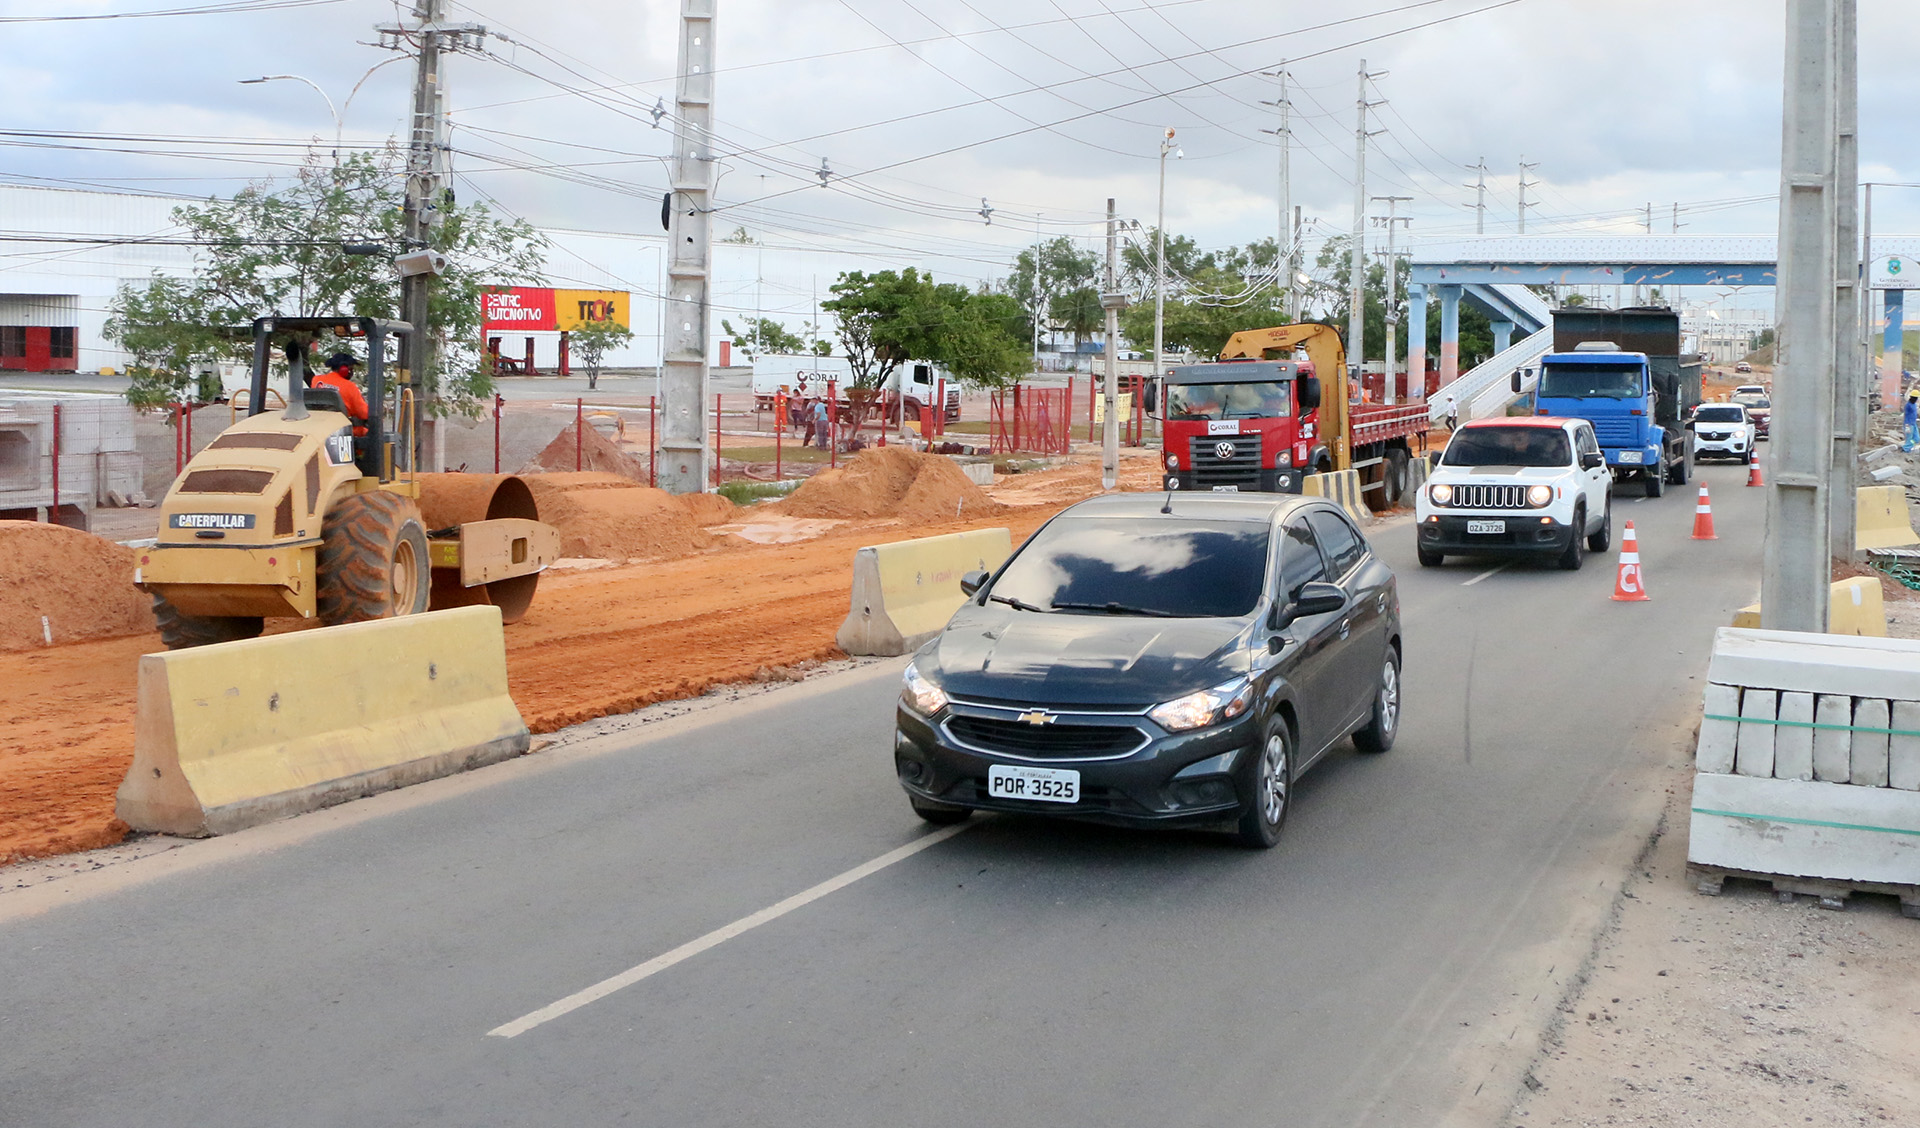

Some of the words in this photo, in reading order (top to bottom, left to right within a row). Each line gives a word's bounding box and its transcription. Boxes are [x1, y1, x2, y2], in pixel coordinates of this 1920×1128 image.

[809, 372, 840, 382] CORAL
[338, 435, 353, 462] CAT
[178, 514, 245, 528] CATERPILLAR
[1620, 564, 1645, 593] C
